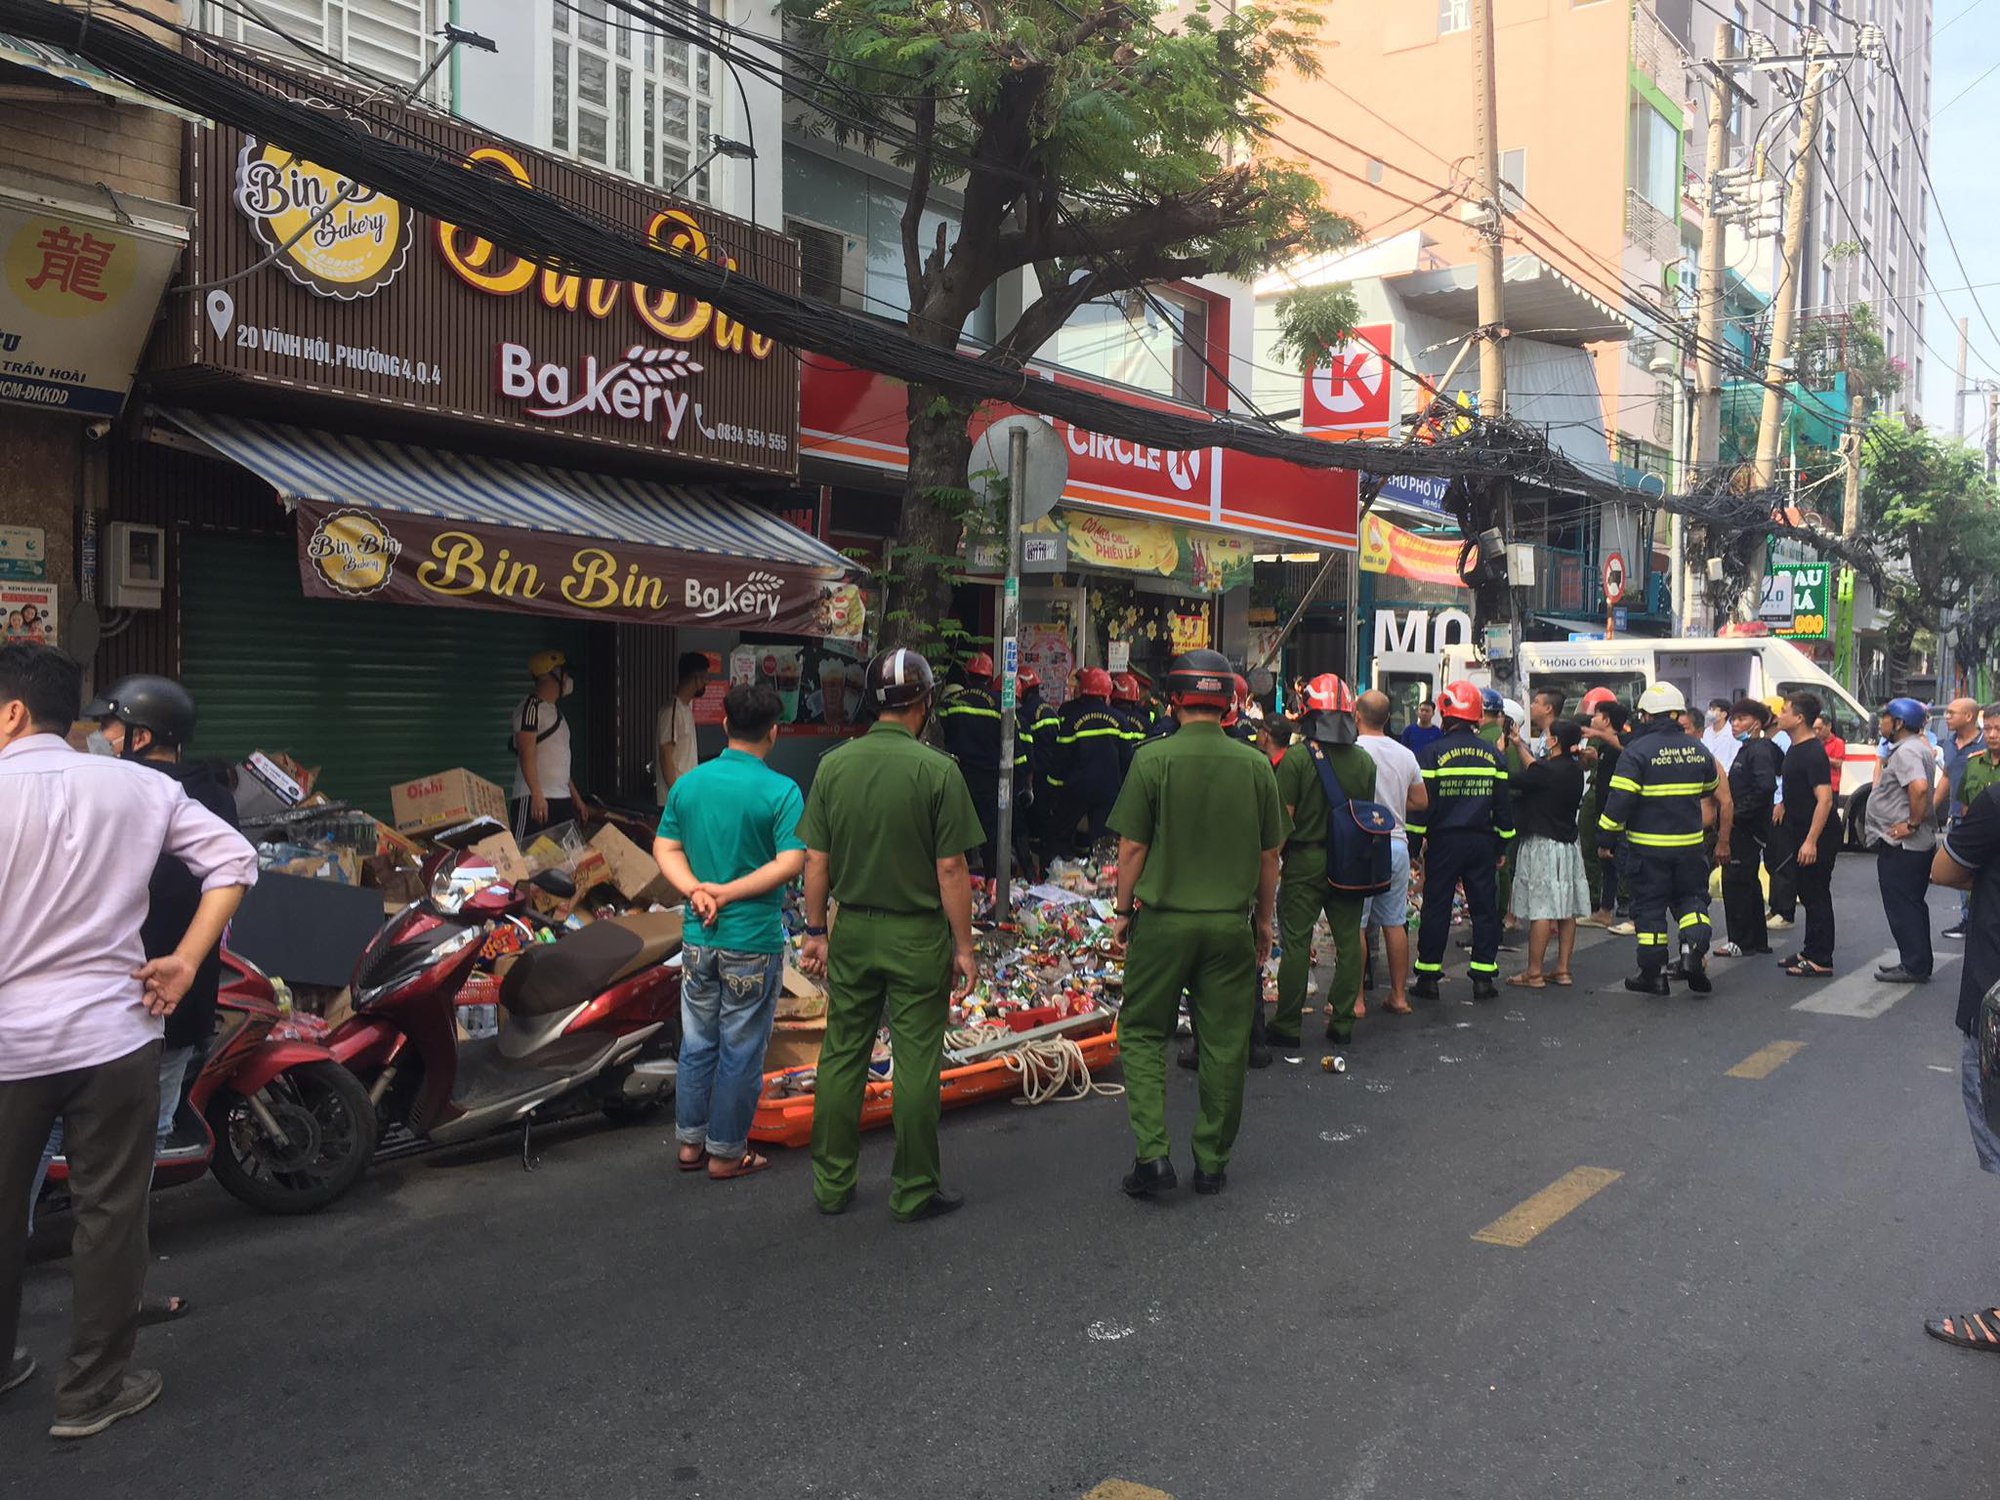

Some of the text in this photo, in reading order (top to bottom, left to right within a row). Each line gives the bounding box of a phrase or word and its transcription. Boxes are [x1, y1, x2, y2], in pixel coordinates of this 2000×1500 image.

[245, 162, 327, 215] Bin
[310, 205, 385, 247] Bakery
[25, 226, 116, 301] 龍
[237, 324, 258, 348] 20
[261, 328, 300, 358] VĨNH
[50, 368, 87, 384] HOÀI
[501, 342, 690, 441] Bakery
[0, 380, 69, 405] CM-ĐKKDD
[717, 422, 787, 451] 0834 554 555
[1067, 423, 1161, 471] CIRCLE
[1434, 483, 1447, 500] VĂ
[309, 532, 400, 558] Bin Bin
[416, 531, 782, 621] Bin Bin Bakery
[1540, 656, 1577, 667] PHÒNG
[407, 778, 443, 800] Oishi
